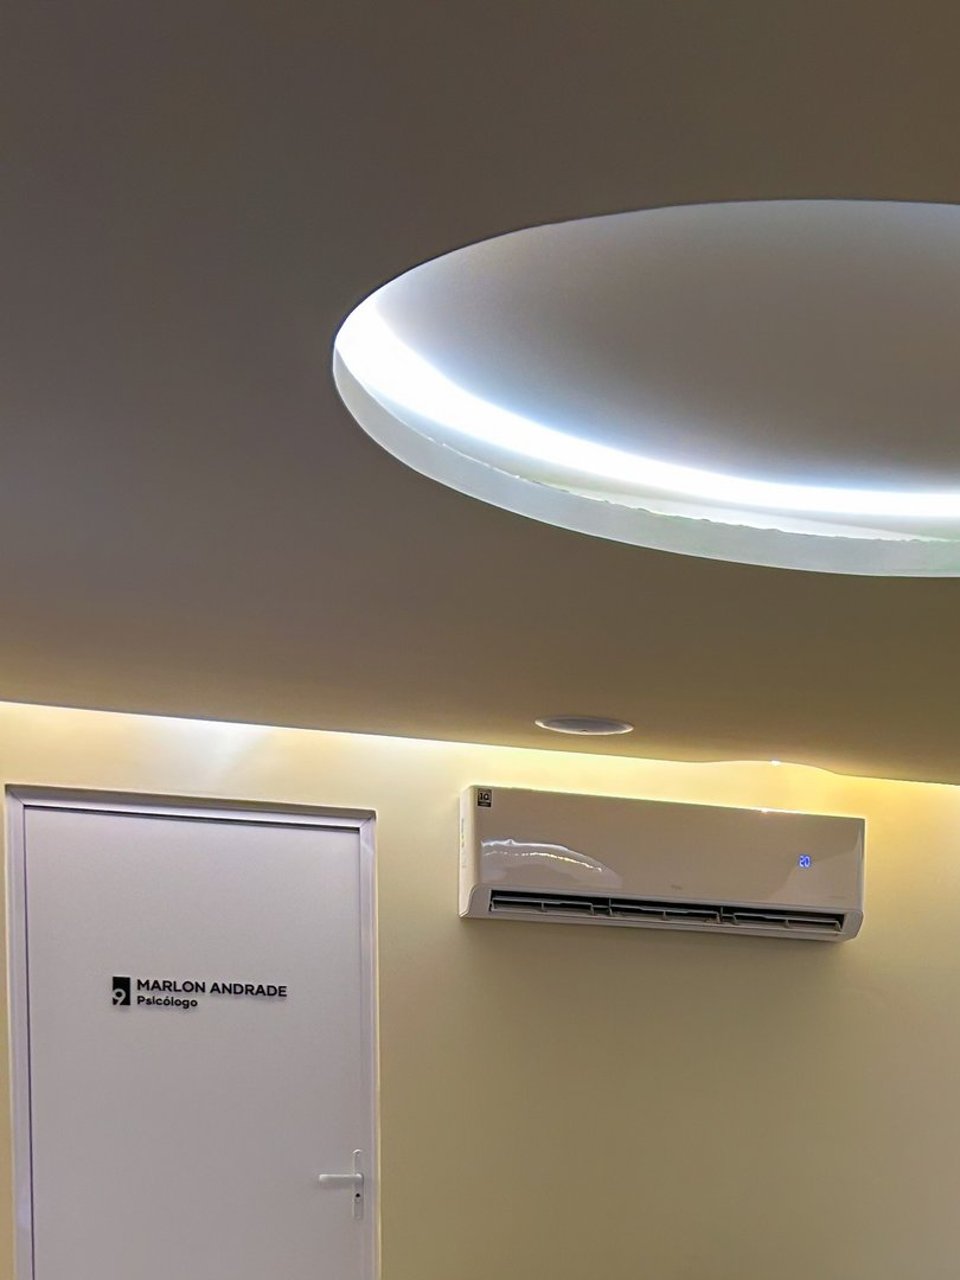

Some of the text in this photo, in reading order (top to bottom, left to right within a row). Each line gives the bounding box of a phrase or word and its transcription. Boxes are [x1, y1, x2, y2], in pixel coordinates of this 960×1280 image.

[137, 979, 288, 998] MARLON ANDRADE
[137, 995, 199, 1010] Psicólogo
